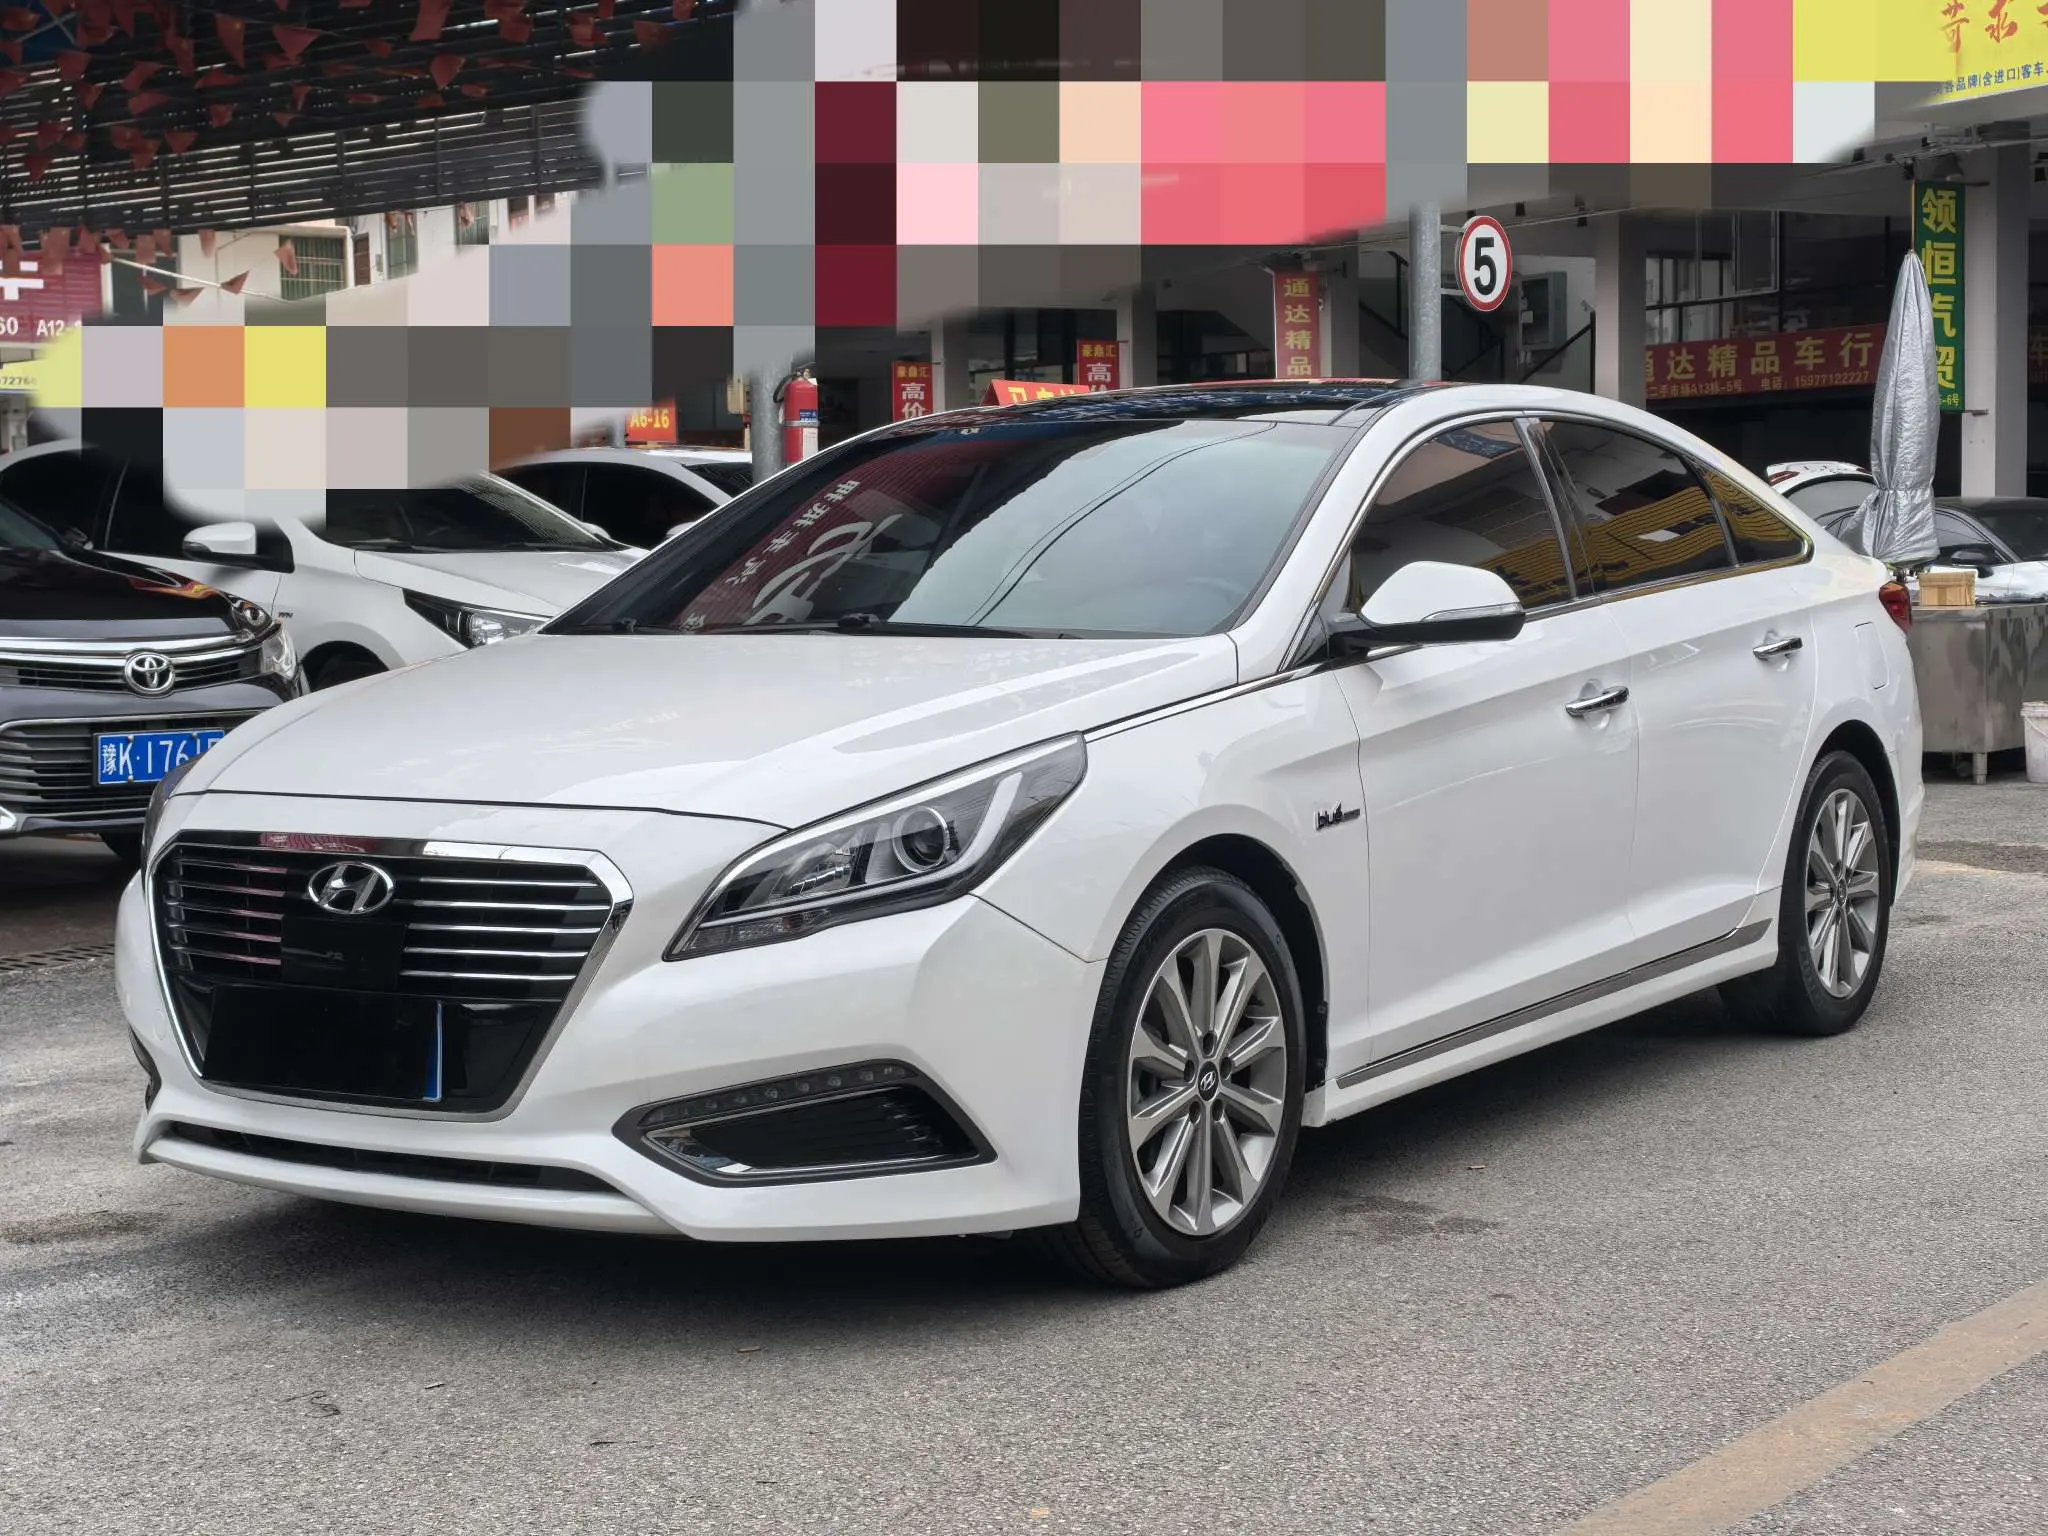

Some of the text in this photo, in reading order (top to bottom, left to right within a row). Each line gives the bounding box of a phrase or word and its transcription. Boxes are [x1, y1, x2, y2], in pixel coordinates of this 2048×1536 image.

[1474, 236, 1497, 296] 5
[1283, 278, 1312, 376] 通达精品
[630, 408, 670, 429] A6-16
